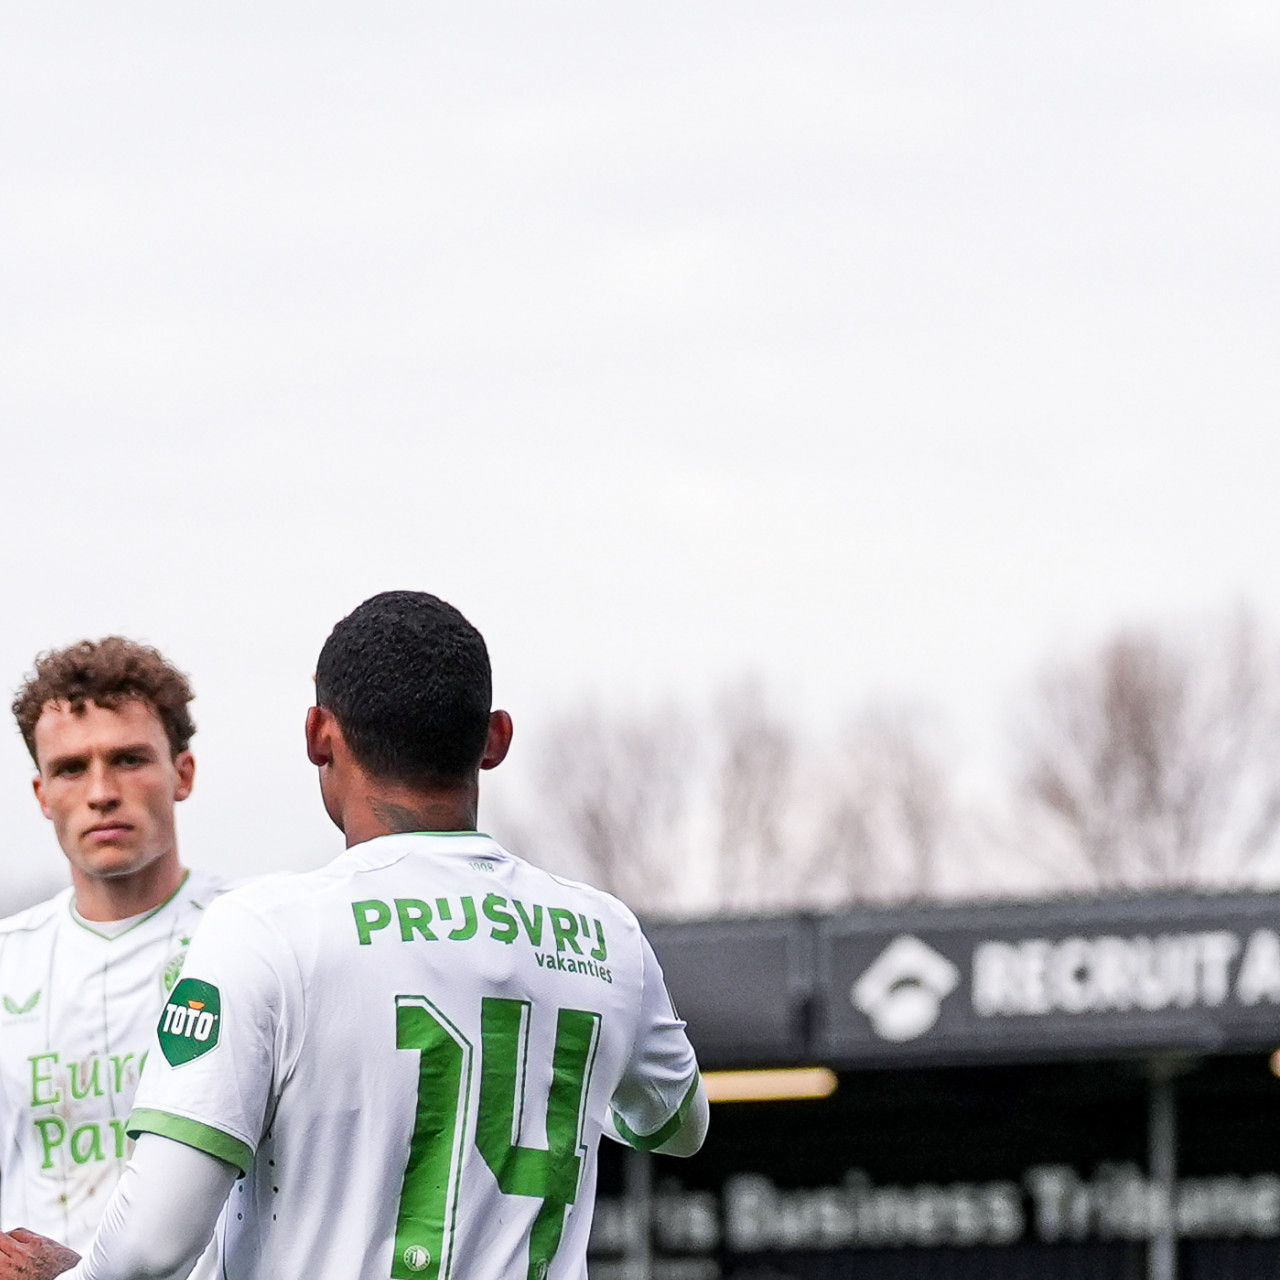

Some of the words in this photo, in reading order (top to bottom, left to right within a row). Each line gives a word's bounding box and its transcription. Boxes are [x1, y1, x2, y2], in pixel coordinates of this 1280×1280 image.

[535, 950, 613, 984] vakanties
[163, 1003, 214, 1042] TOTO
[27, 1051, 147, 1107] Eur
[34, 1119, 132, 1170] Par
